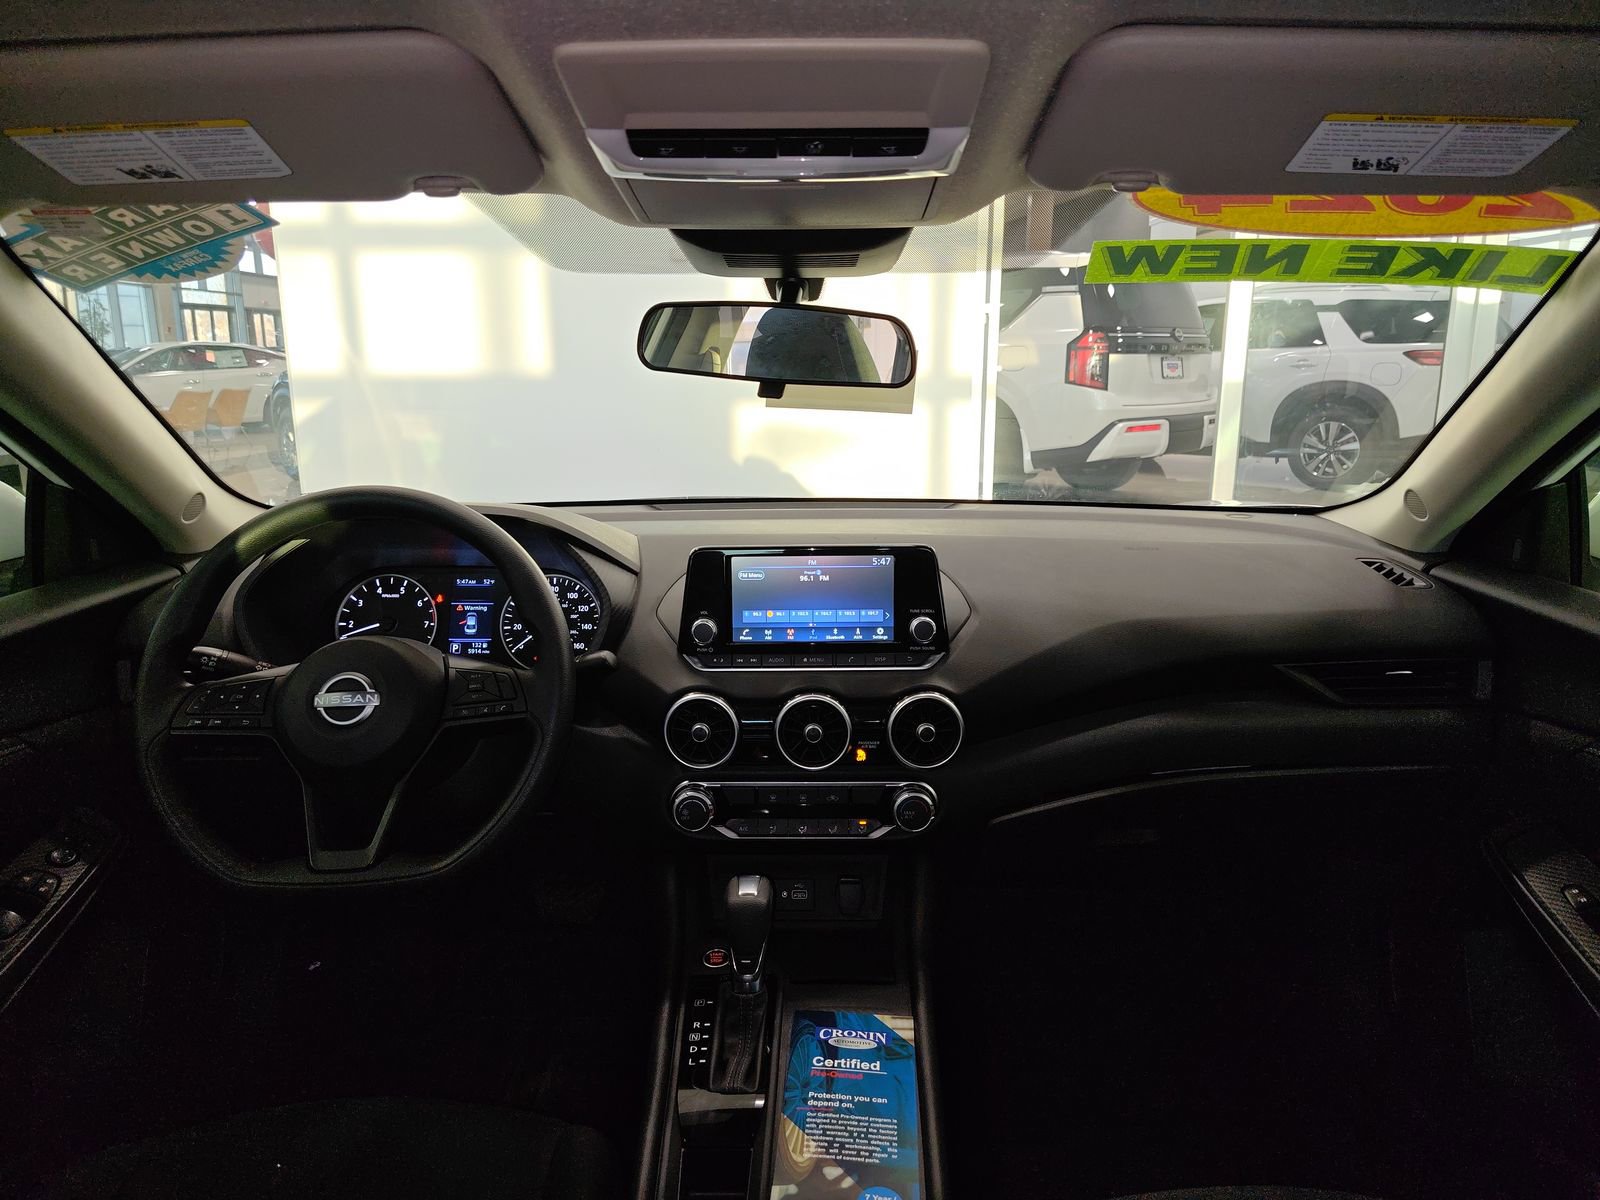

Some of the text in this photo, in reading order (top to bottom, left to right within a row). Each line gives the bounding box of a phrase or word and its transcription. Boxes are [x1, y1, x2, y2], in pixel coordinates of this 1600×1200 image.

[872, 557, 891, 565] 5:47
[314, 694, 378, 706] NISSAN
[819, 1028, 886, 1045] CRONIN
[812, 1056, 881, 1071] Certified
[810, 1070, 864, 1079] Pre-Owned
[808, 1091, 852, 1100] Protection
[807, 1099, 839, 1108] depend
